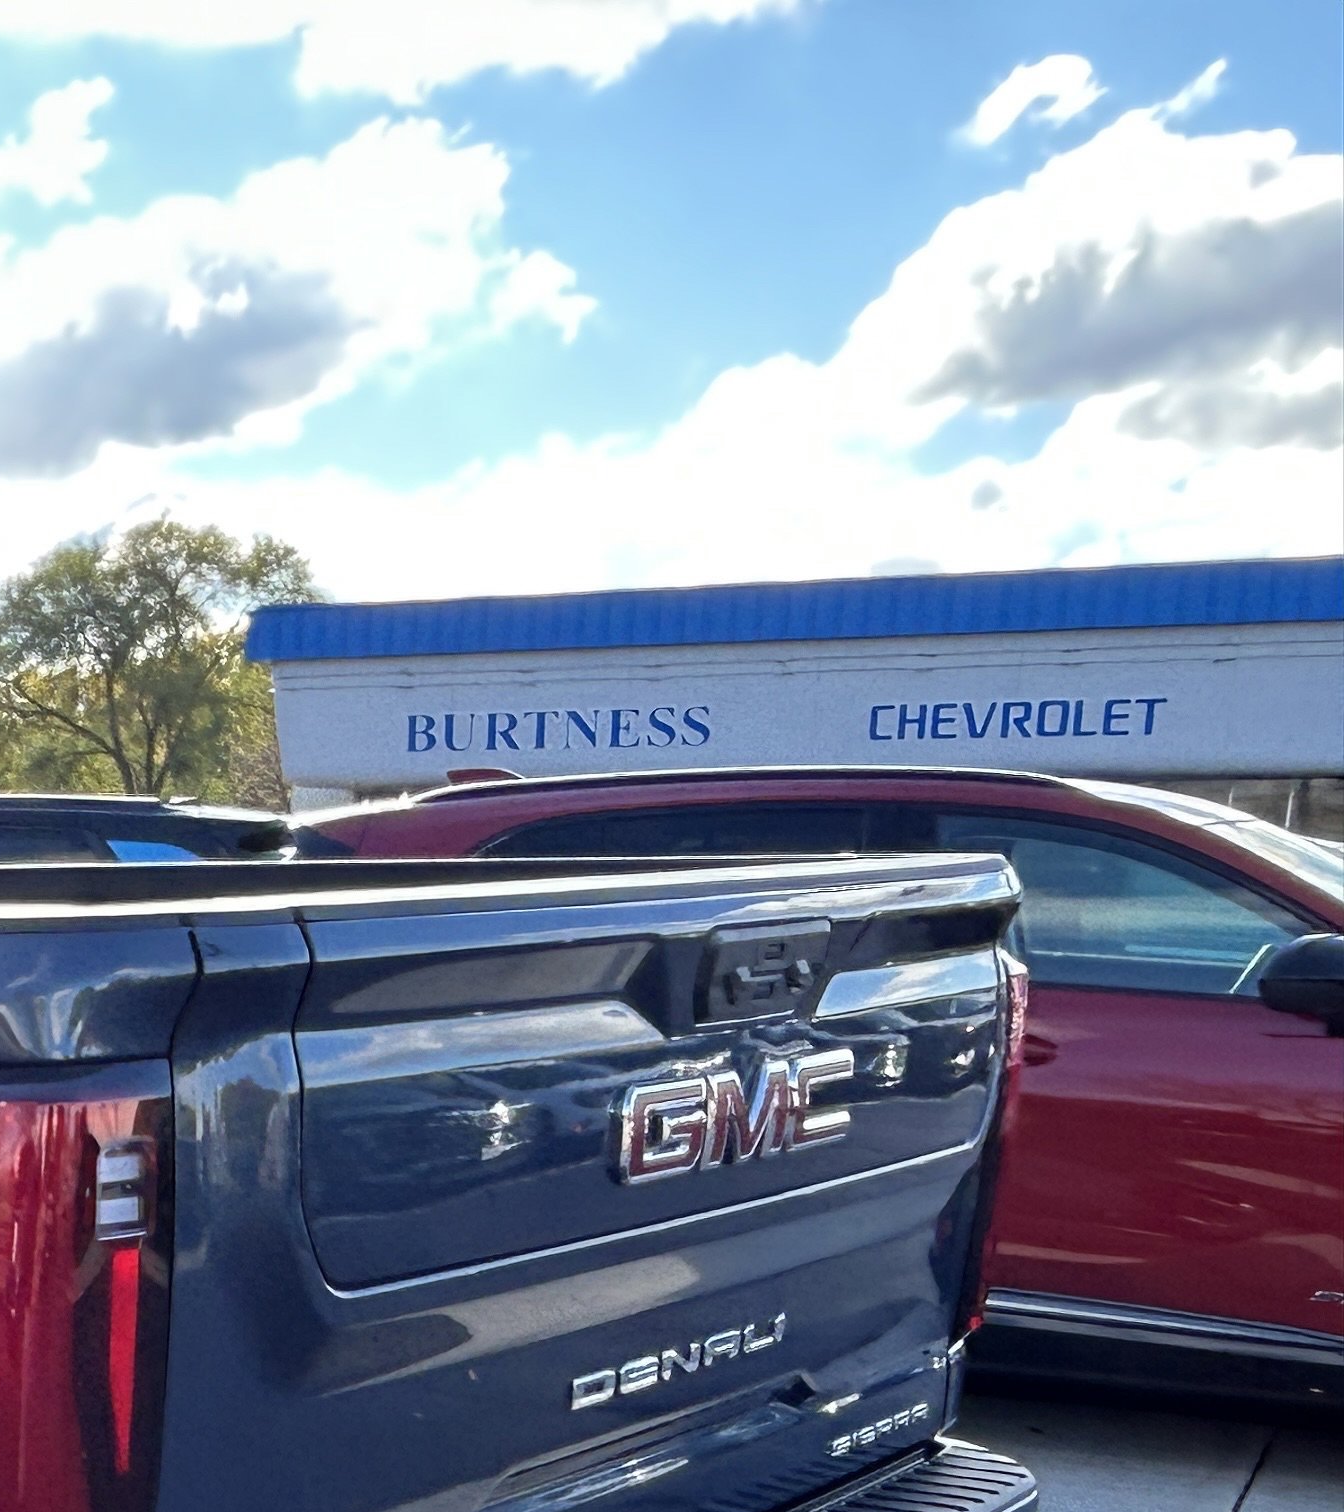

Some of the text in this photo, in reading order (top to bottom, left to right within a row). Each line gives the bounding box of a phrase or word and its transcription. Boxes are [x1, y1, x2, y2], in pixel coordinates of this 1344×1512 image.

[406, 698, 1168, 752] BURTNESS CHEVROLET
[621, 1048, 854, 1185] GMC
[571, 1312, 787, 1410] DENALI
[827, 1402, 929, 1457] SIERRA
